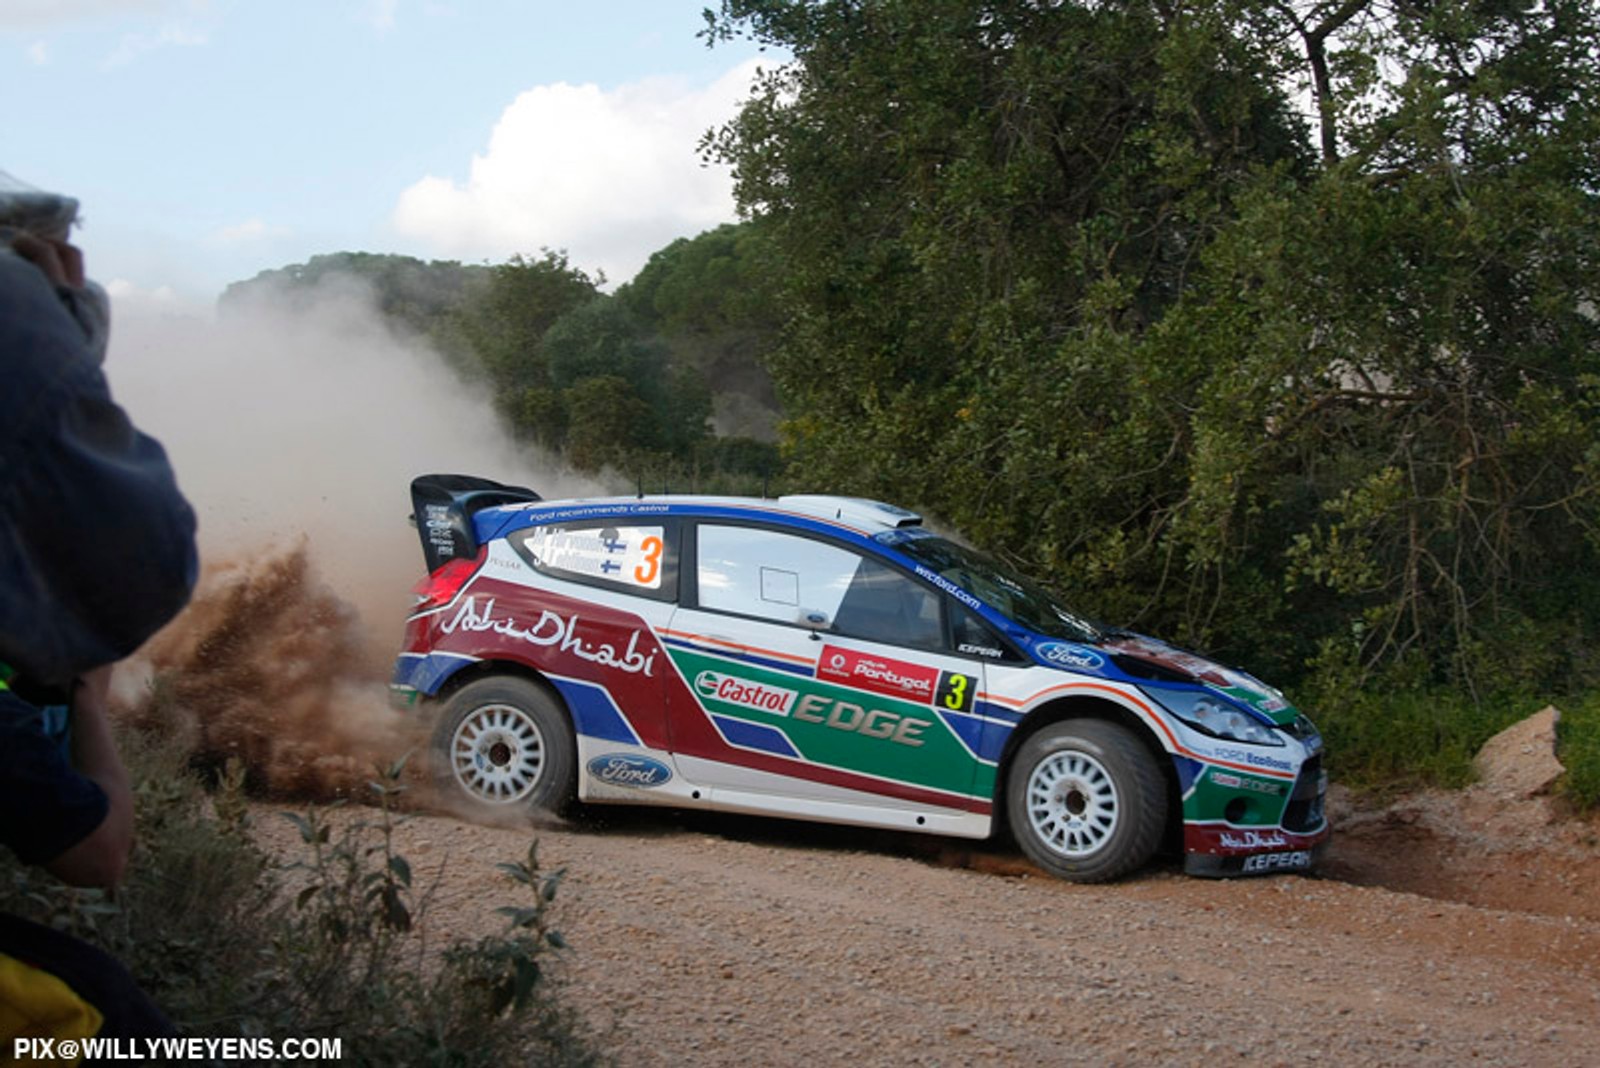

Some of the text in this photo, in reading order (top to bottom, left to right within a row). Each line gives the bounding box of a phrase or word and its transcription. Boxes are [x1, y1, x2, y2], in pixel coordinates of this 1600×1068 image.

[530, 504, 669, 522] Ford recommends Castrol
[634, 536, 664, 583] 3
[914, 564, 981, 610] wrcford.com
[441, 597, 658, 677] Abu Dhabi
[1047, 643, 1093, 667] Ford
[854, 664, 931, 691] Portugal
[945, 673, 967, 710] 3
[717, 677, 933, 747] Castrol EDGE
[602, 757, 656, 783] Ford
